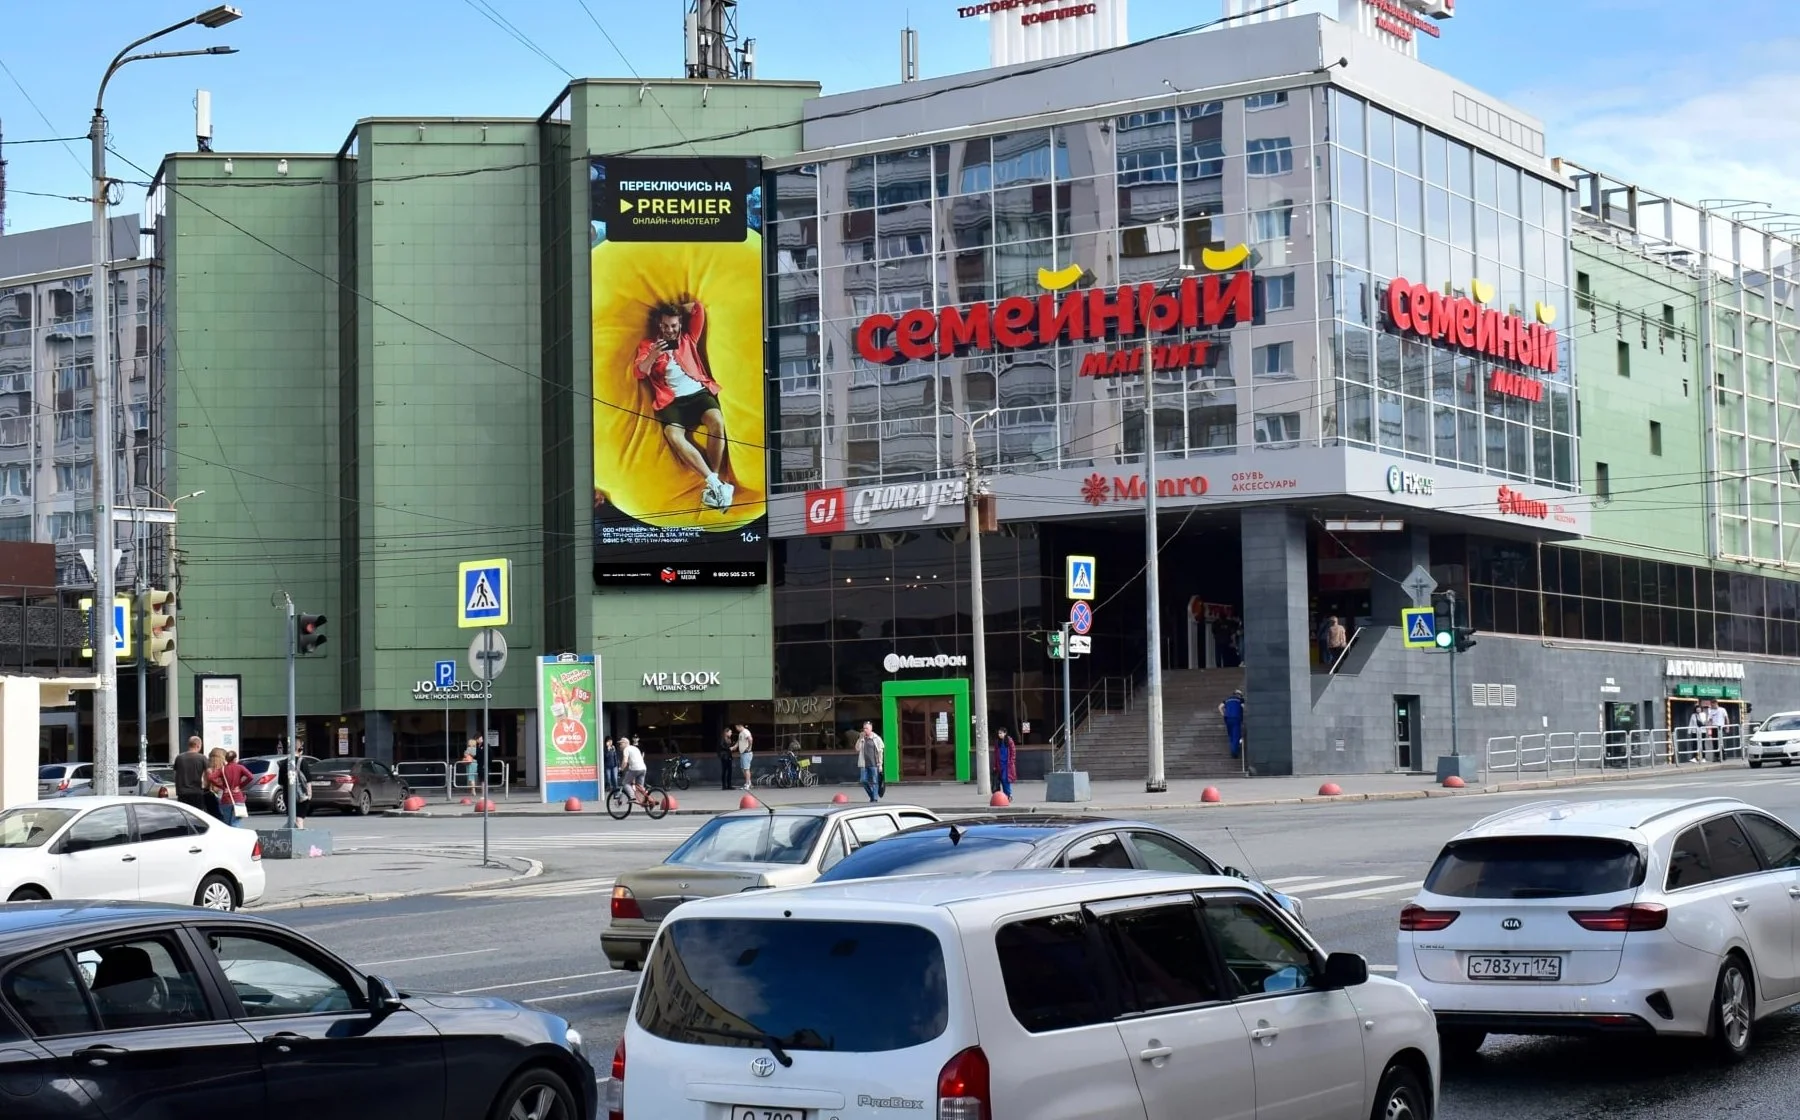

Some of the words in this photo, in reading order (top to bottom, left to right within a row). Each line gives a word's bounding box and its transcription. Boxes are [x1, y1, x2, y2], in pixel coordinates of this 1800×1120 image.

[1021, 3, 1096, 26] КОМПЛЕКС
[619, 181, 712, 192] ПЕРЕКЛЮЧИСЬ
[715, 181, 732, 192] НА
[638, 199, 731, 214] PREMIER
[632, 217, 720, 225] ОНЛАЙН-КИНОТЕАТР
[1080, 340, 1211, 377] МАГНИТ
[1490, 370, 1544, 402] МАГНИТ
[1231, 471, 1264, 481] ОБУВЬ
[1231, 479, 1297, 492] АКСЕССУАРЫ
[922, 480, 966, 521] JEA
[810, 498, 836, 523] GJ
[740, 532, 761, 543] 16+
[1666, 660, 1745, 679] АВТОПАРКОВКА
[642, 672, 668, 686] MP
[673, 671, 720, 686] LOOK
[1503, 920, 1520, 928] KIA
[1533, 958, 1557, 972] 174
